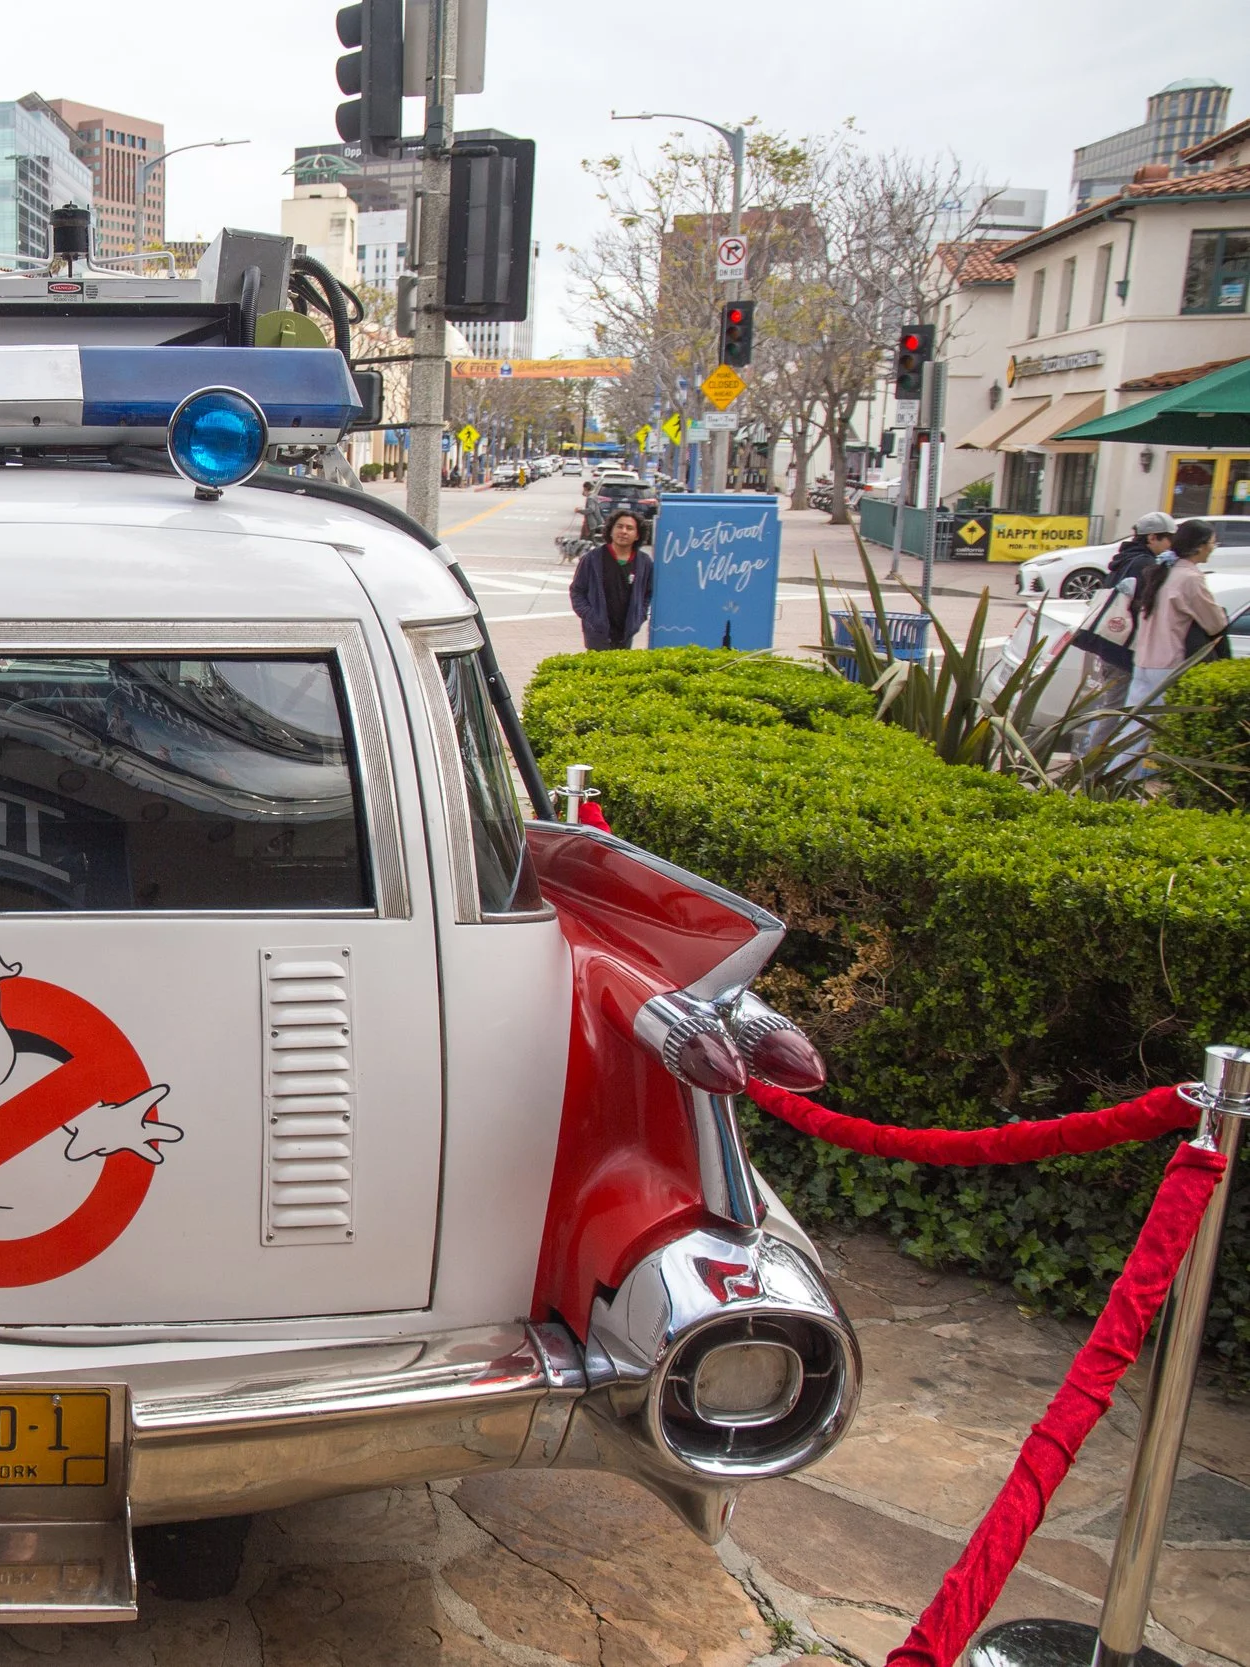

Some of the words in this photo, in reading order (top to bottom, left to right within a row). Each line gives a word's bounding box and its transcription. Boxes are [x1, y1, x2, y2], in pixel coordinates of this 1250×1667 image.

[730, 268, 743, 276] RED
[470, 365, 498, 373] FREE
[708, 380, 740, 389] CLOSED
[663, 512, 768, 564] Westwood
[996, 528, 1038, 540] HAPPY
[1041, 529, 1083, 541] HOURS
[696, 553, 769, 593] Village
